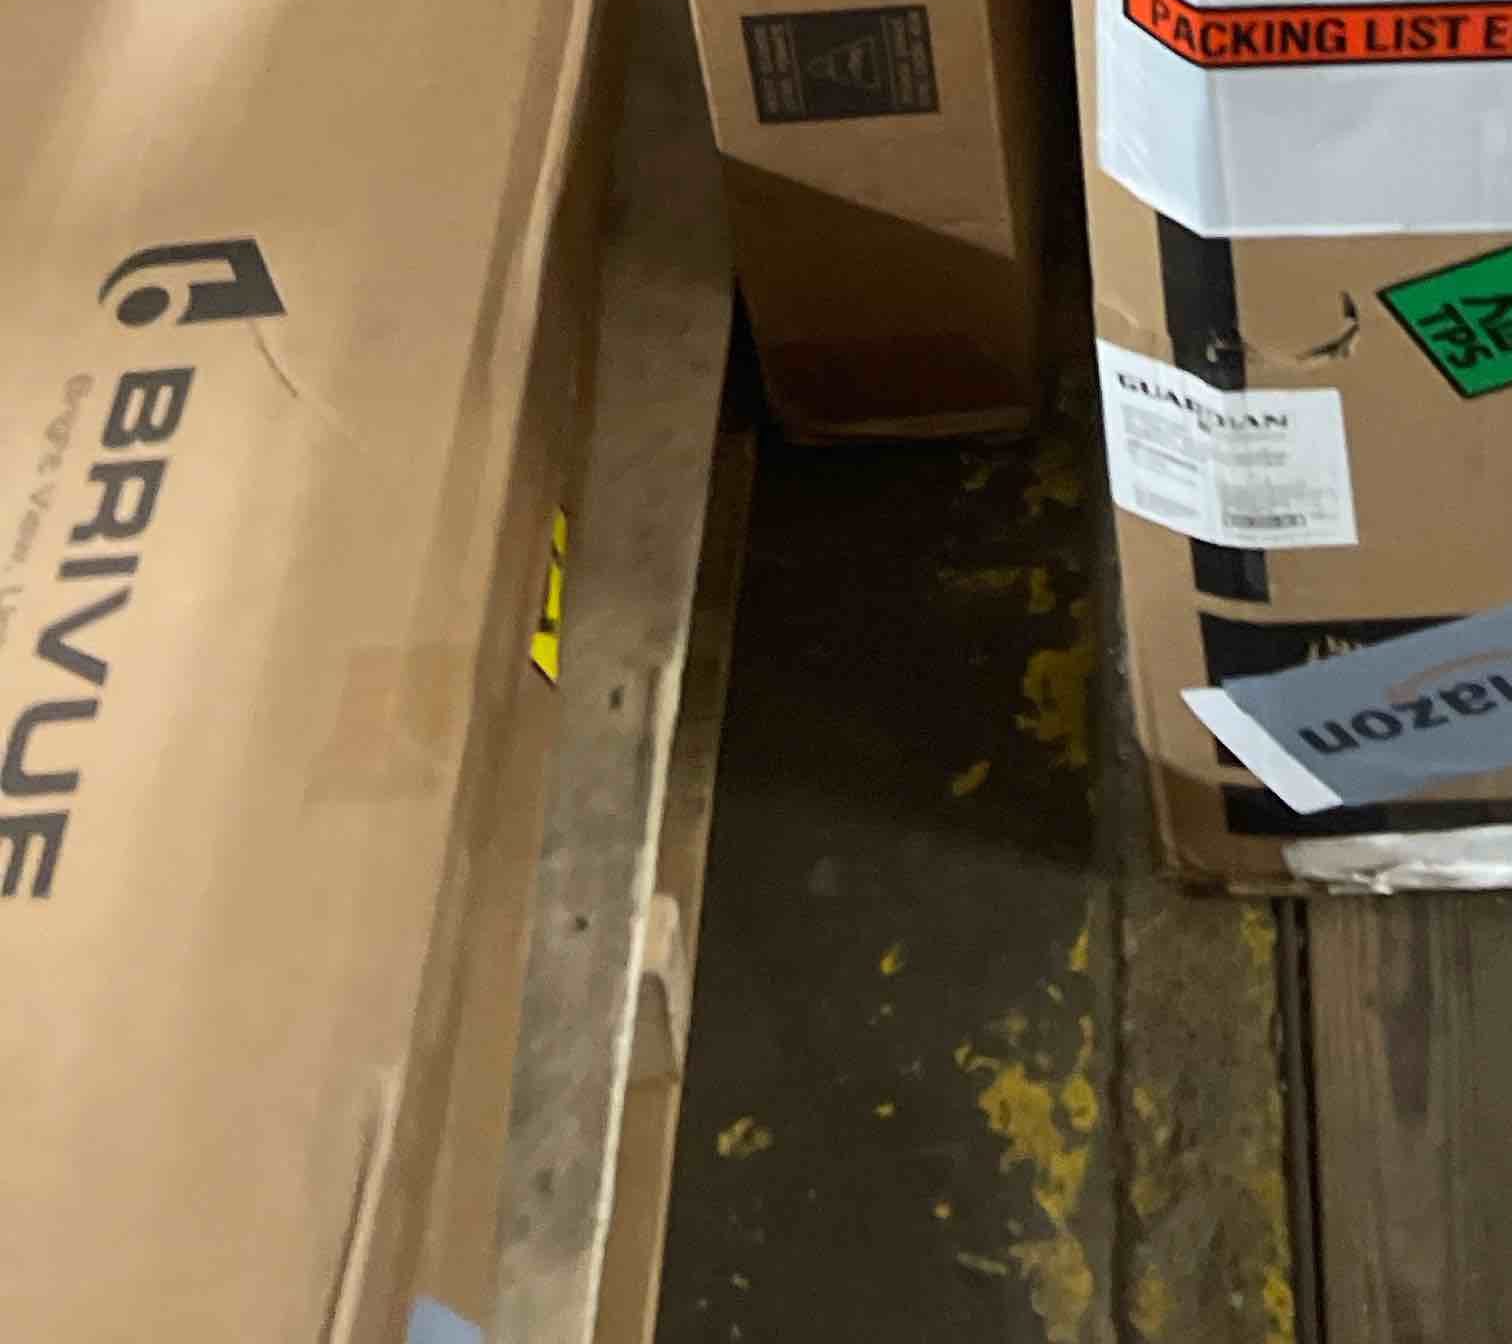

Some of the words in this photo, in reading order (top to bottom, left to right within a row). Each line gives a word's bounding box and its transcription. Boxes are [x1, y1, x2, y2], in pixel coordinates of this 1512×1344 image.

[1363, 13, 1467, 54] LIST
[1417, 302, 1495, 369] TPS
[0, 365, 195, 902] BRIVUE
